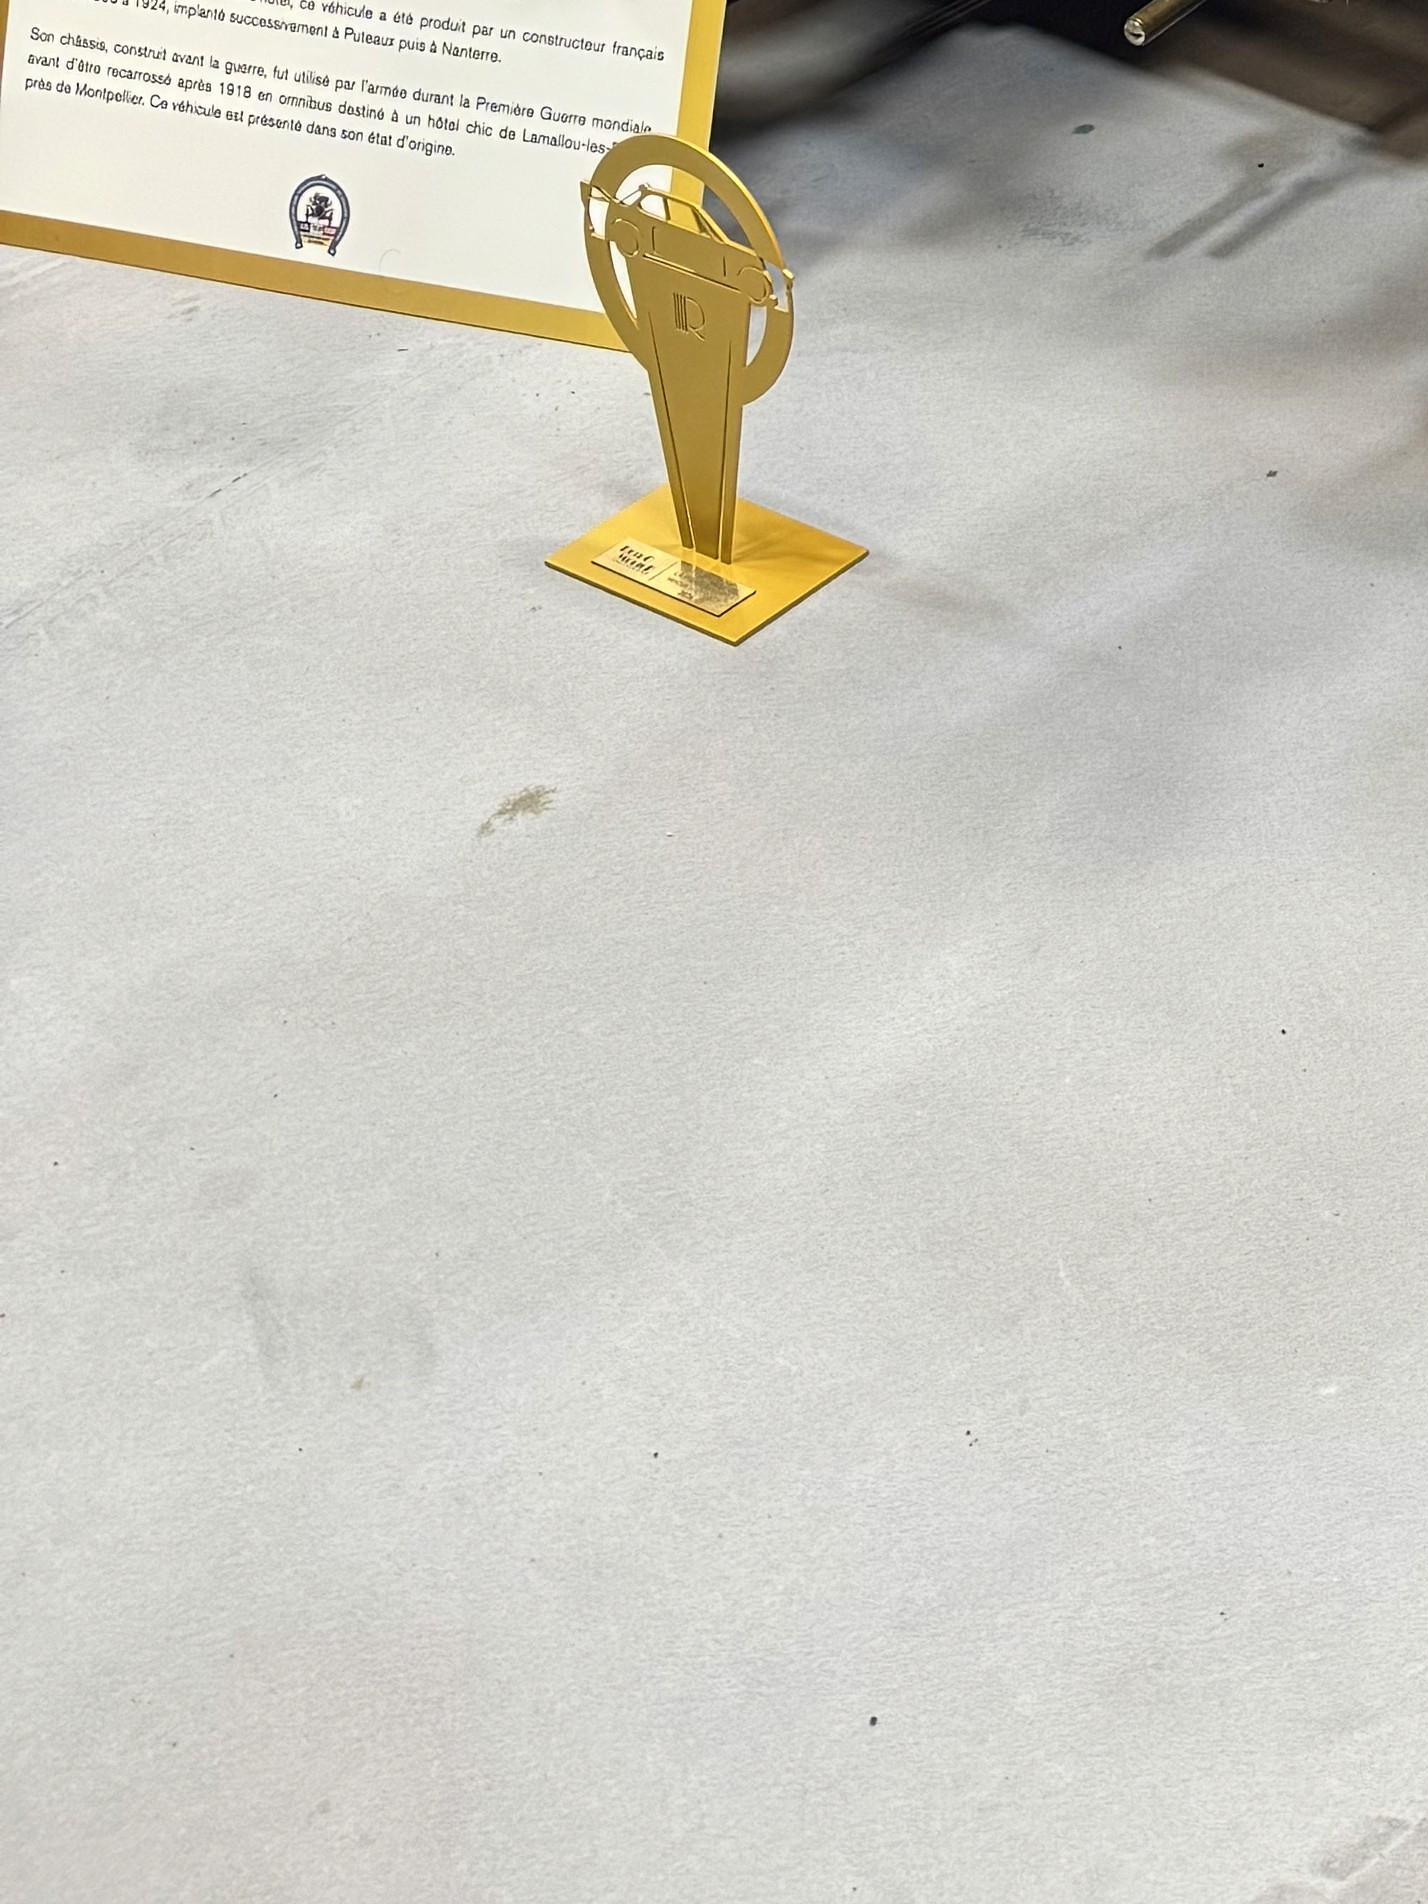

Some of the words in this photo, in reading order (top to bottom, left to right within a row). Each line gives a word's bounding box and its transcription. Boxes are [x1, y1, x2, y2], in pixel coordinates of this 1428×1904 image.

[174, 2, 225, 23] implanté
[229, 11, 328, 39] successivement
[332, 24, 340, 40] à
[344, 27, 396, 47] Puteaux
[398, 39, 426, 54] puis
[430, 41, 438, 55] à
[442, 43, 502, 64] Nanterre.
[299, 0, 315, 11] ce
[321, 0, 373, 20] véhicule
[379, 12, 387, 22] a
[393, 11, 413, 25] été
[420, 15, 466, 34] produit
[472, 24, 494, 39] par
[500, 27, 516, 40] un
[522, 31, 606, 54] constructeur
[612, 40, 665, 62] français
[27, 54, 60, 69] avant
[107, 66, 172, 86] recarrossé
[178, 77, 212, 94] après
[219, 83, 252, 99] 1918
[257, 91, 273, 103] en
[279, 88, 333, 113] omnibus
[338, 100, 385, 121] destiné
[391, 109, 399, 123] à
[405, 113, 421, 127] un
[427, 113, 460, 133] hôtel
[465, 120, 493, 137] chic
[499, 126, 516, 141] de
[30, 27, 55, 43] Son
[114, 42, 167, 61] construit
[172, 52, 205, 67] avant
[209, 55, 220, 69] la
[225, 60, 268, 80] guerre,
[273, 65, 289, 81] fut
[294, 68, 330, 88] utilisé
[335, 79, 355, 94] par
[412, 88, 454, 107] durant
[459, 94, 470, 109] la
[476, 97, 535, 119] Première
[540, 106, 586, 127] Guerre
[25, 78, 52, 93] près
[56, 82, 72, 96] de
[149, 94, 168, 110] Ce
[172, 99, 221, 120] véhicule
[225, 110, 244, 123] est
[247, 112, 302, 134] présenté
[306, 121, 337, 139] dans
[341, 128, 363, 142] son
[368, 132, 392, 147] état
